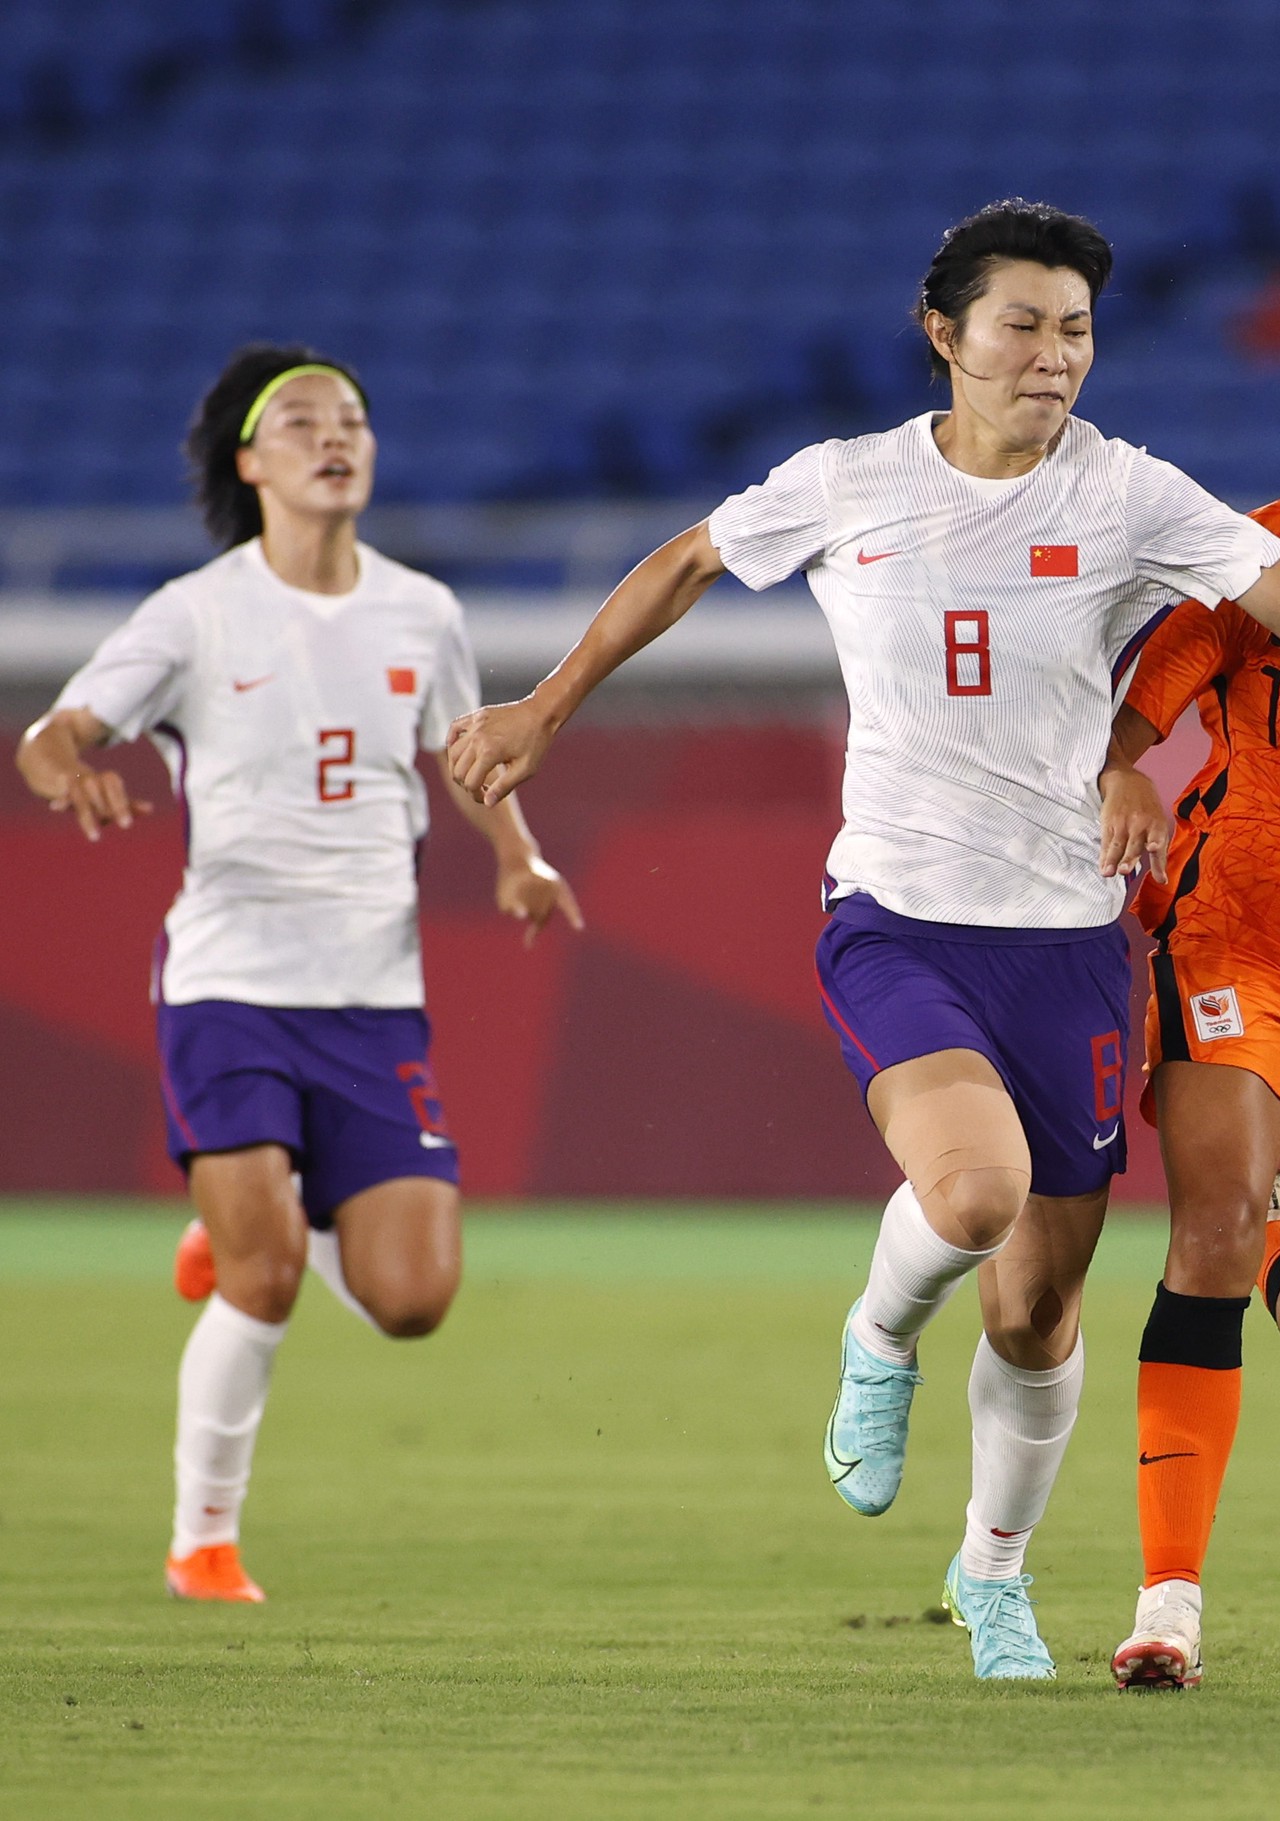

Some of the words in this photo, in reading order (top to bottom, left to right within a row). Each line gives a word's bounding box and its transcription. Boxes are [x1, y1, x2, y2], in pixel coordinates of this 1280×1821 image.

[944, 610, 992, 696] 8
[318, 729, 354, 803] 2
[1090, 1029, 1123, 1122] 8
